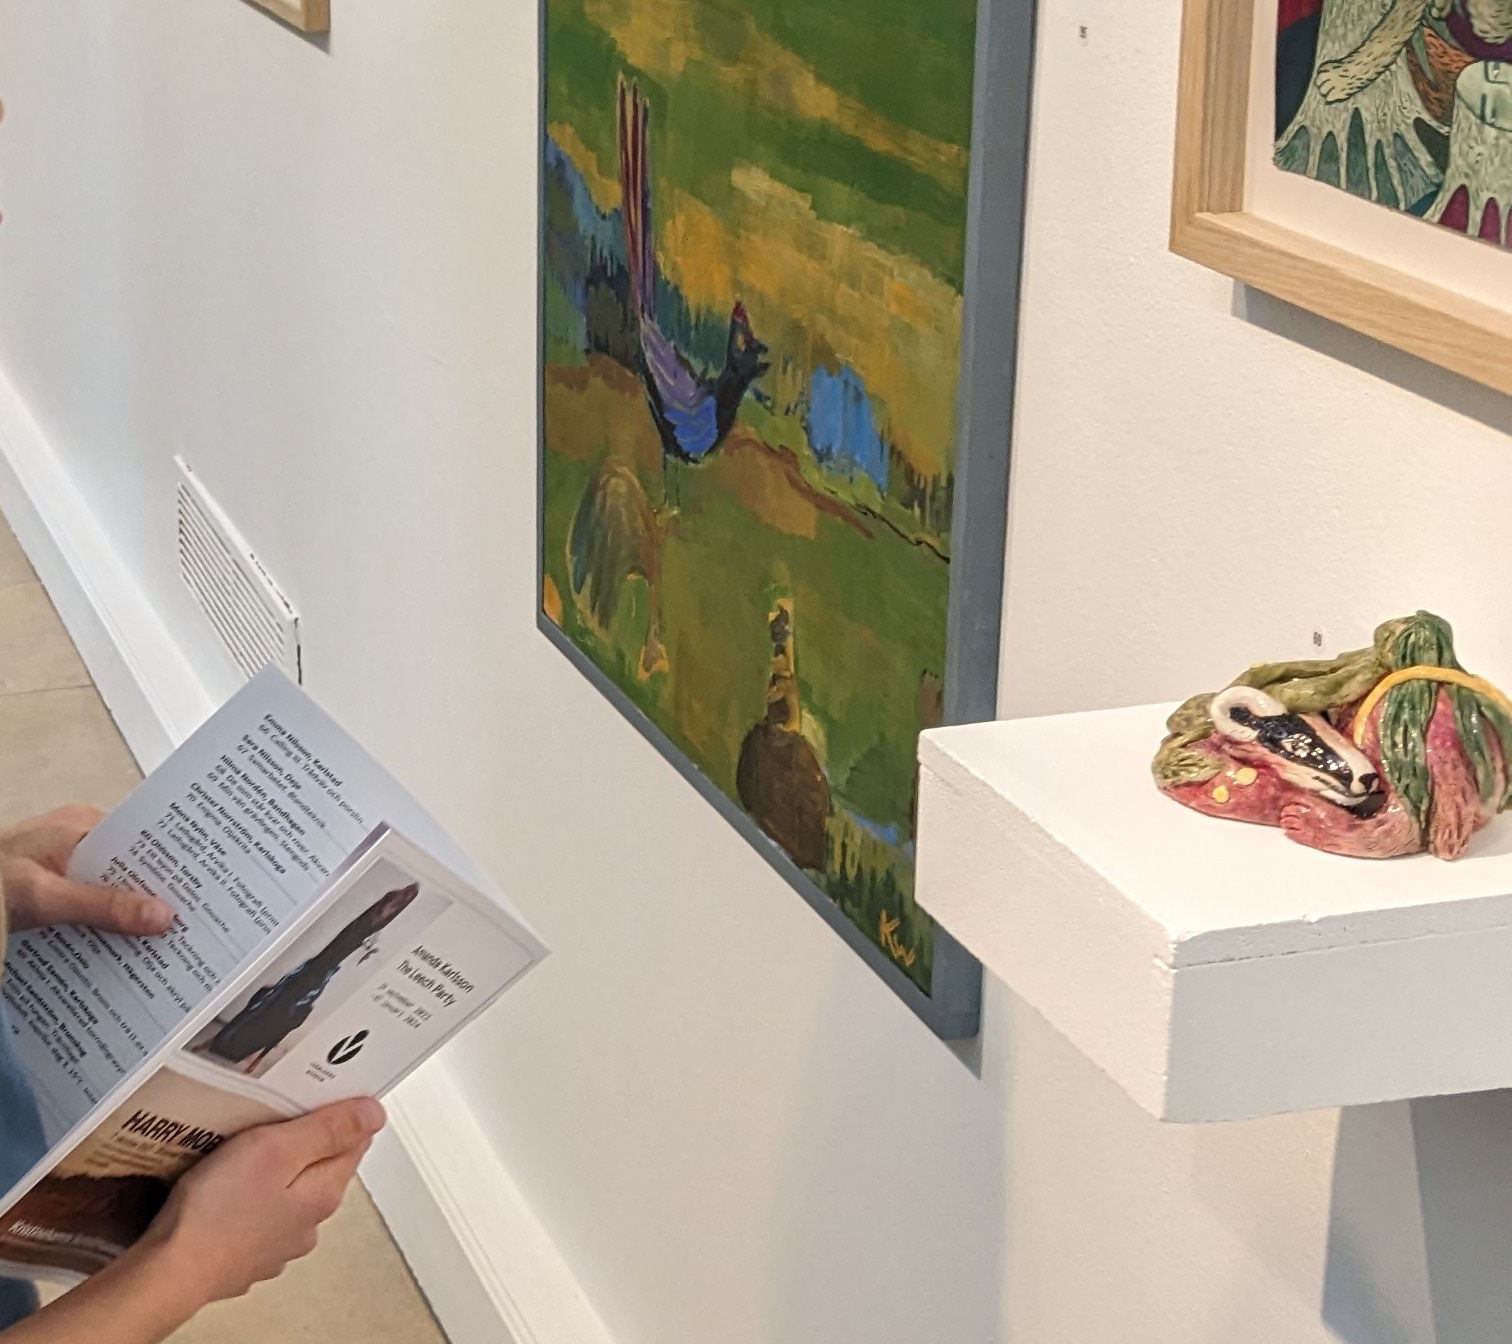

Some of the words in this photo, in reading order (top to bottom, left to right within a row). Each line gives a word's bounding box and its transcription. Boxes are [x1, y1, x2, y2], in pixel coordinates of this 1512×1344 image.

[264, 714, 286, 736] Emma
[313, 759, 343, 786] Karlstad
[268, 799, 305, 835] Bandhagen
[253, 841, 286, 874] Karlskoga
[180, 865, 202, 888] Torsby
[142, 940, 169, 969] Karlstad
[397, 960, 413, 974] The
[431, 984, 456, 1007] Party
[439, 963, 474, 993] Karlsson
[70, 990, 98, 1024] Karlskoga
[121, 1110, 191, 1143] HARRY
